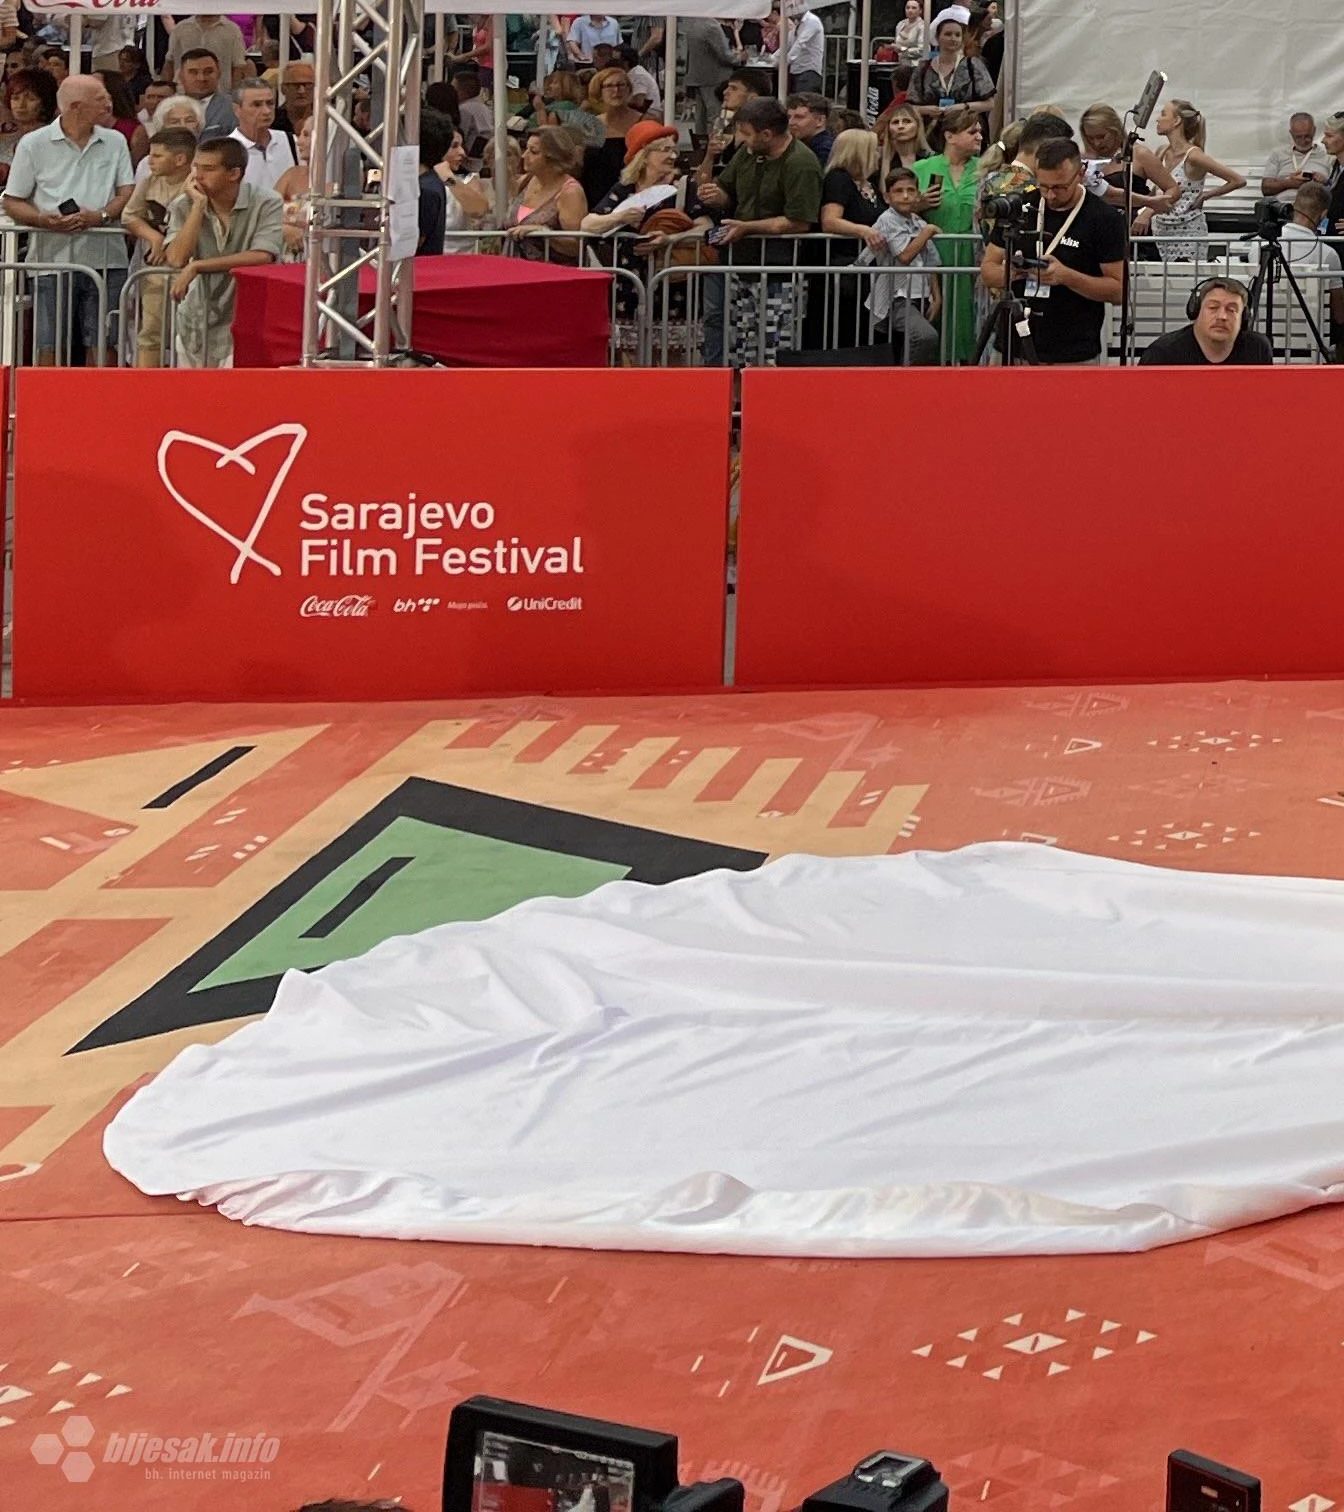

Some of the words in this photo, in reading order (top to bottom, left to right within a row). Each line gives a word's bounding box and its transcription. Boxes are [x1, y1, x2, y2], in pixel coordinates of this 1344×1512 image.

[300, 492, 495, 539] Sarajevo
[301, 538, 397, 576] Film
[415, 536, 585, 575] Festival
[300, 594, 374, 617] Coca-Cola
[524, 597, 583, 610] UniCredit
